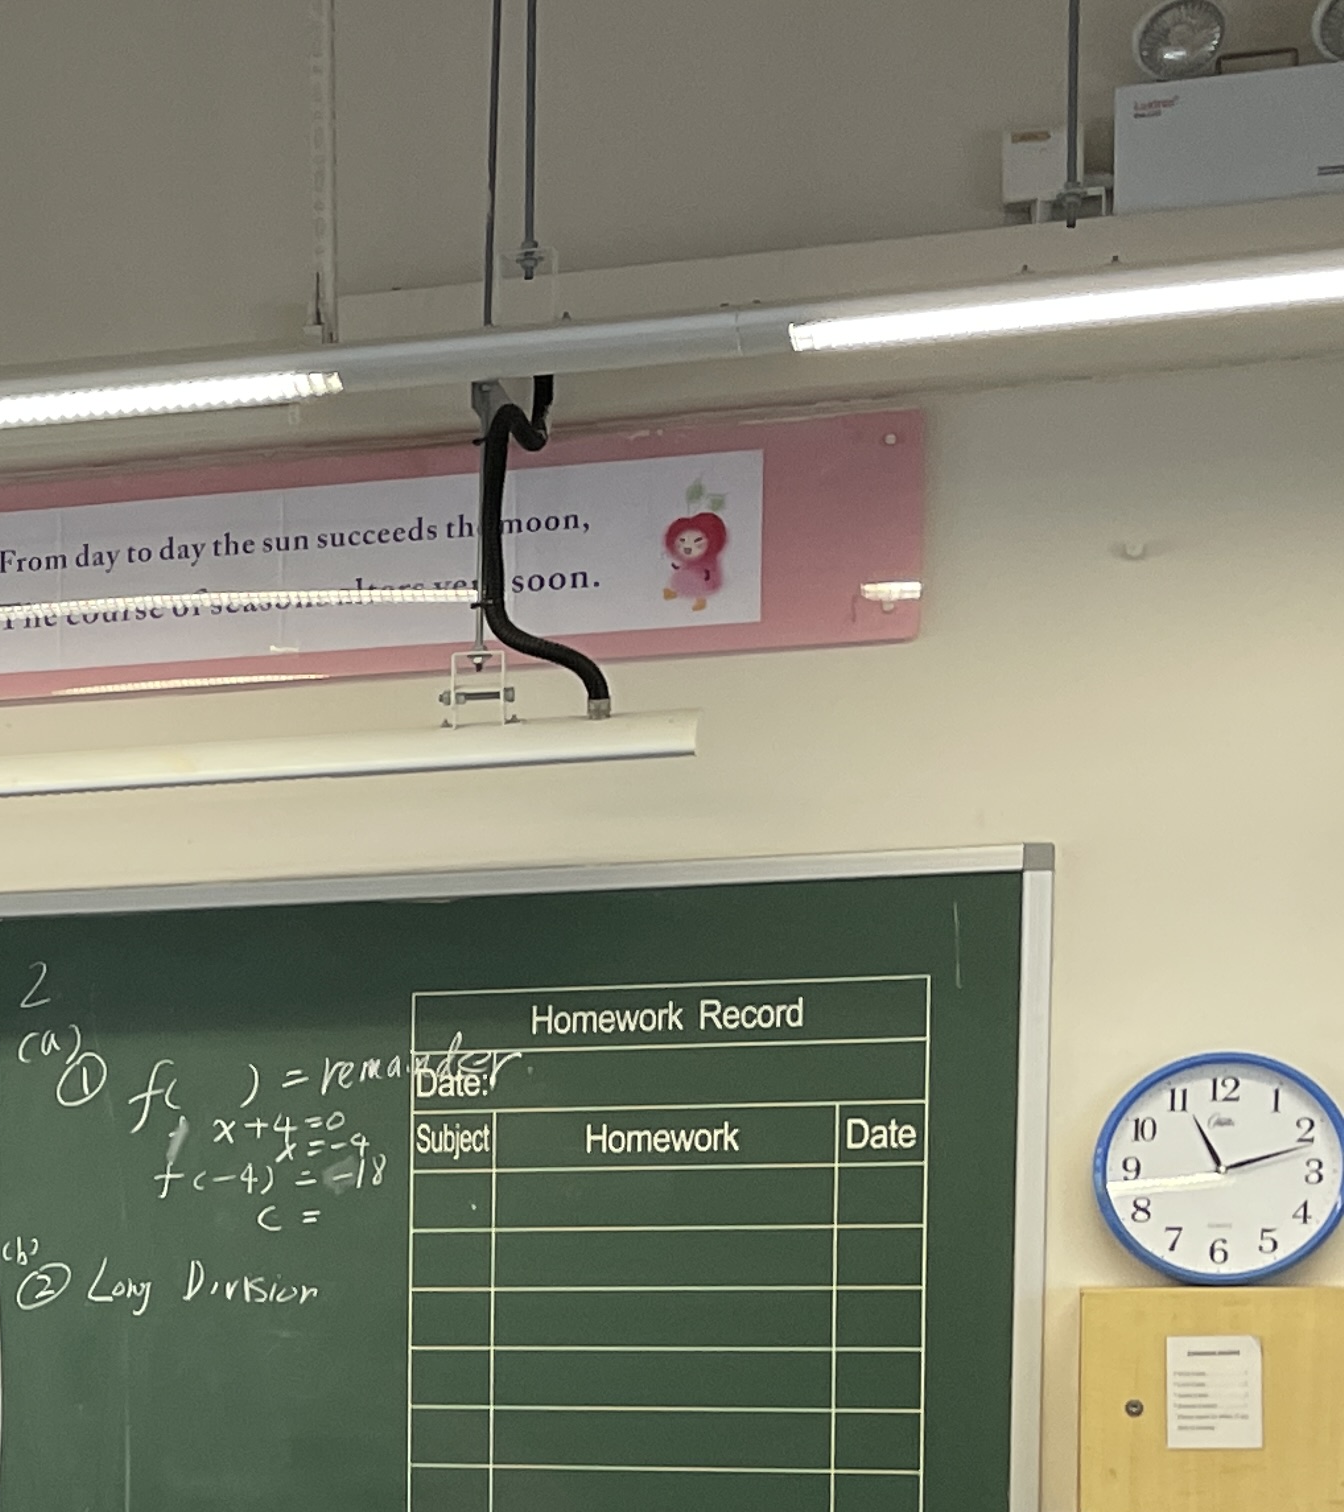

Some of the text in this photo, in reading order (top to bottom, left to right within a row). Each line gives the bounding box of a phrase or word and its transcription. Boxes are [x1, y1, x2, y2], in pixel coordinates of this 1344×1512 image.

[75, 543, 121, 574] day
[127, 545, 152, 564] to
[159, 536, 206, 567] day
[212, 531, 255, 557] the
[262, 534, 309, 553] sun
[317, 516, 438, 549] succeeds
[446, 514, 479, 539] th
[501, 512, 591, 535] moon,
[511, 569, 601, 594] soon.
[20, 960, 52, 1009] 2
[531, 997, 804, 1036] Homework Record
[416, 1067, 488, 1098] Date:
[1210, 1075, 1241, 1102] 12
[1167, 1087, 1188, 1113] 11
[1271, 1087, 1282, 1113] 1
[416, 1117, 918, 1159] Subject Homework Date
[1130, 1116, 1157, 1142] 10
[1295, 1116, 1315, 1143] 2
[1304, 1158, 1324, 1185] 3
[1130, 1196, 1151, 1223] 8
[1291, 1199, 1313, 1225] 4
[1164, 1226, 1184, 1252] 7
[1209, 1238, 1229, 1265] 6
[1258, 1227, 1279, 1254] 5
[87, 1256, 152, 1316] Long
[182, 1259, 319, 1305] Division
